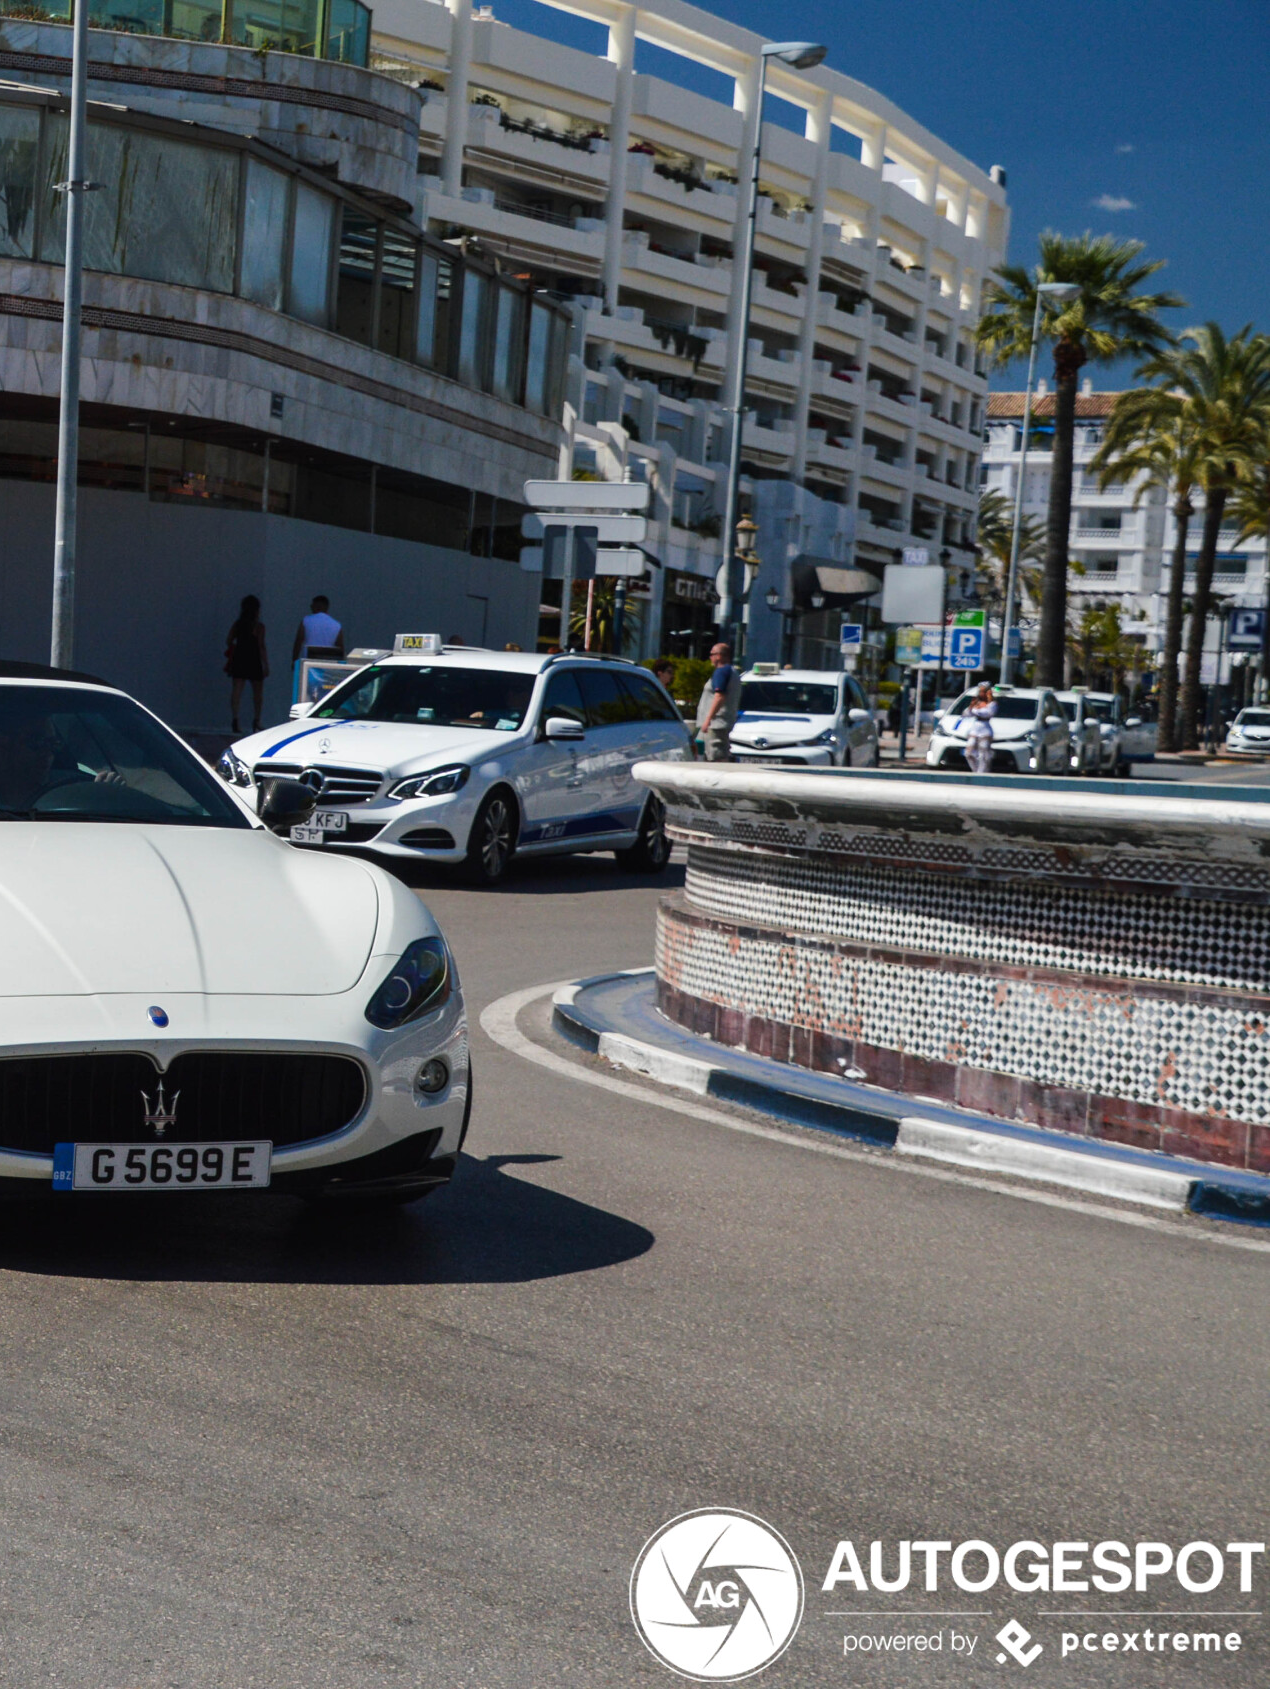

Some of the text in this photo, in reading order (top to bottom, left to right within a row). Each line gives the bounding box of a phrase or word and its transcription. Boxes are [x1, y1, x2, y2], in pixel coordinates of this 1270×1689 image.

[1236, 612, 1259, 634] P
[403, 637, 424, 648] TAXI
[958, 633, 976, 653] P
[539, 820, 567, 840] Taxi
[53, 1170, 72, 1181] GBZ
